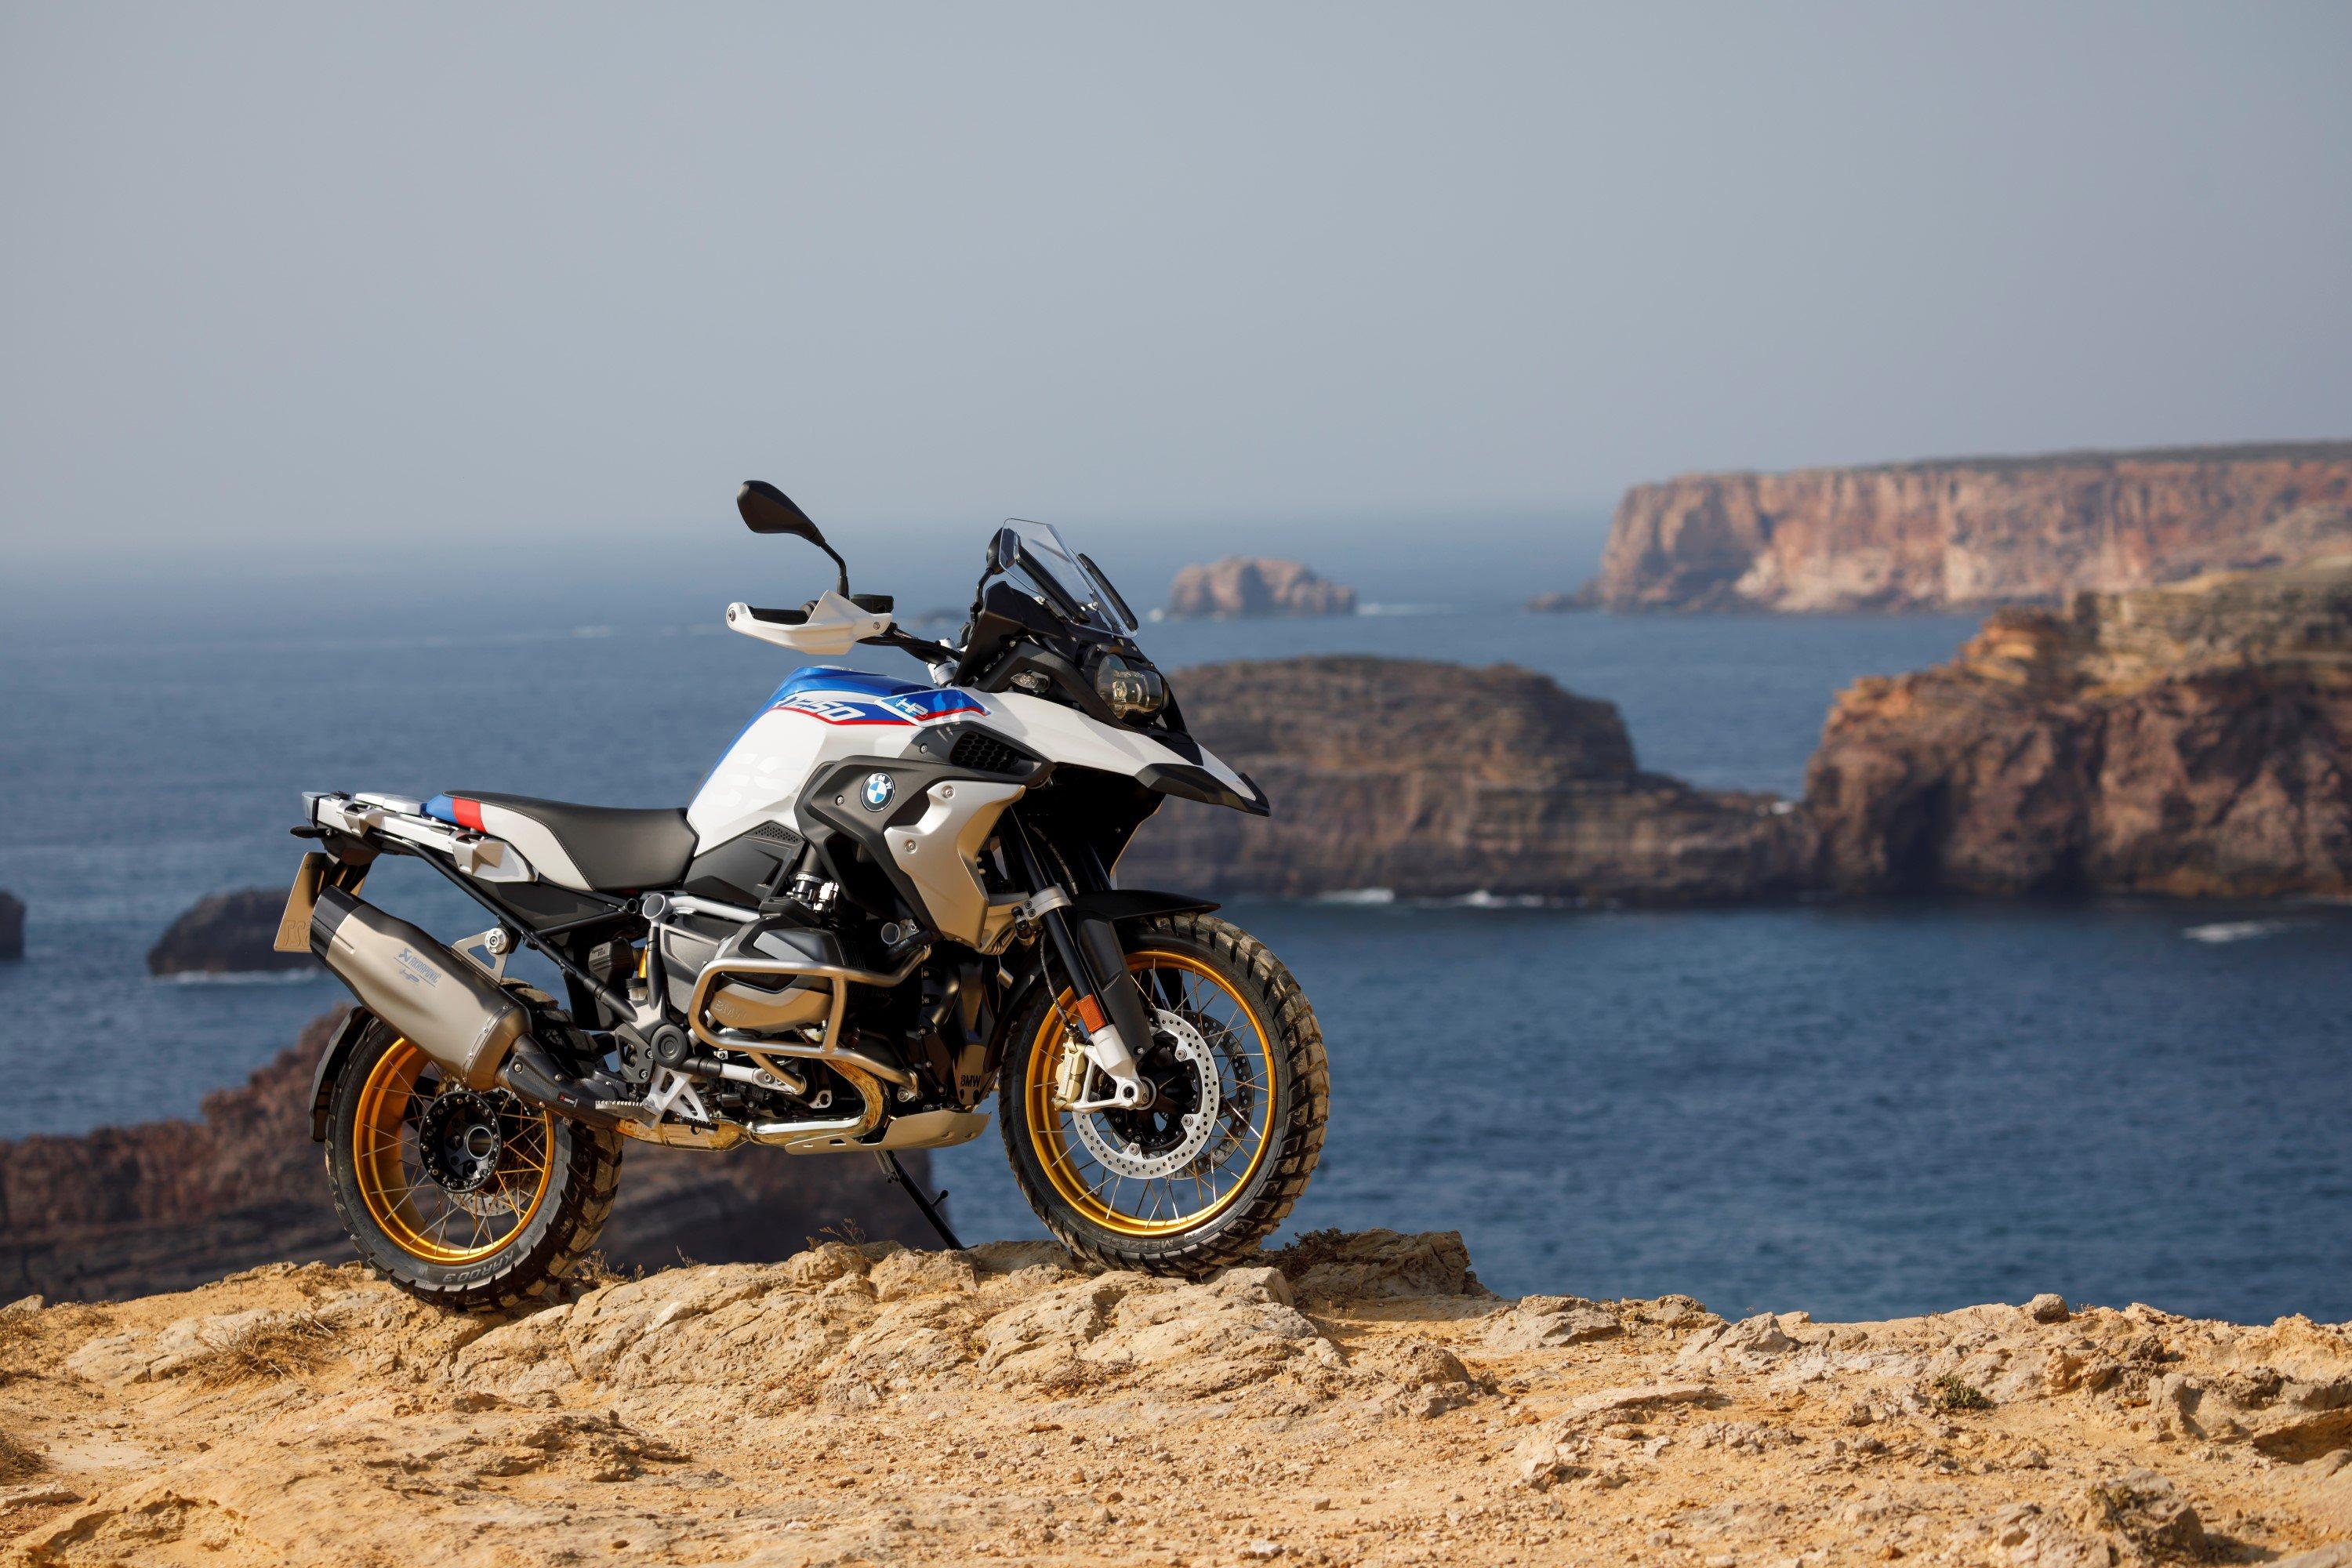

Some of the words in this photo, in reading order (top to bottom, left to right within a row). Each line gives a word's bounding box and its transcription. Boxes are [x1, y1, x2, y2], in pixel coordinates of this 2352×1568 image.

[895, 695, 928, 717] HP
[714, 998, 746, 1020] BMW
[960, 1074, 982, 1087] BMW
